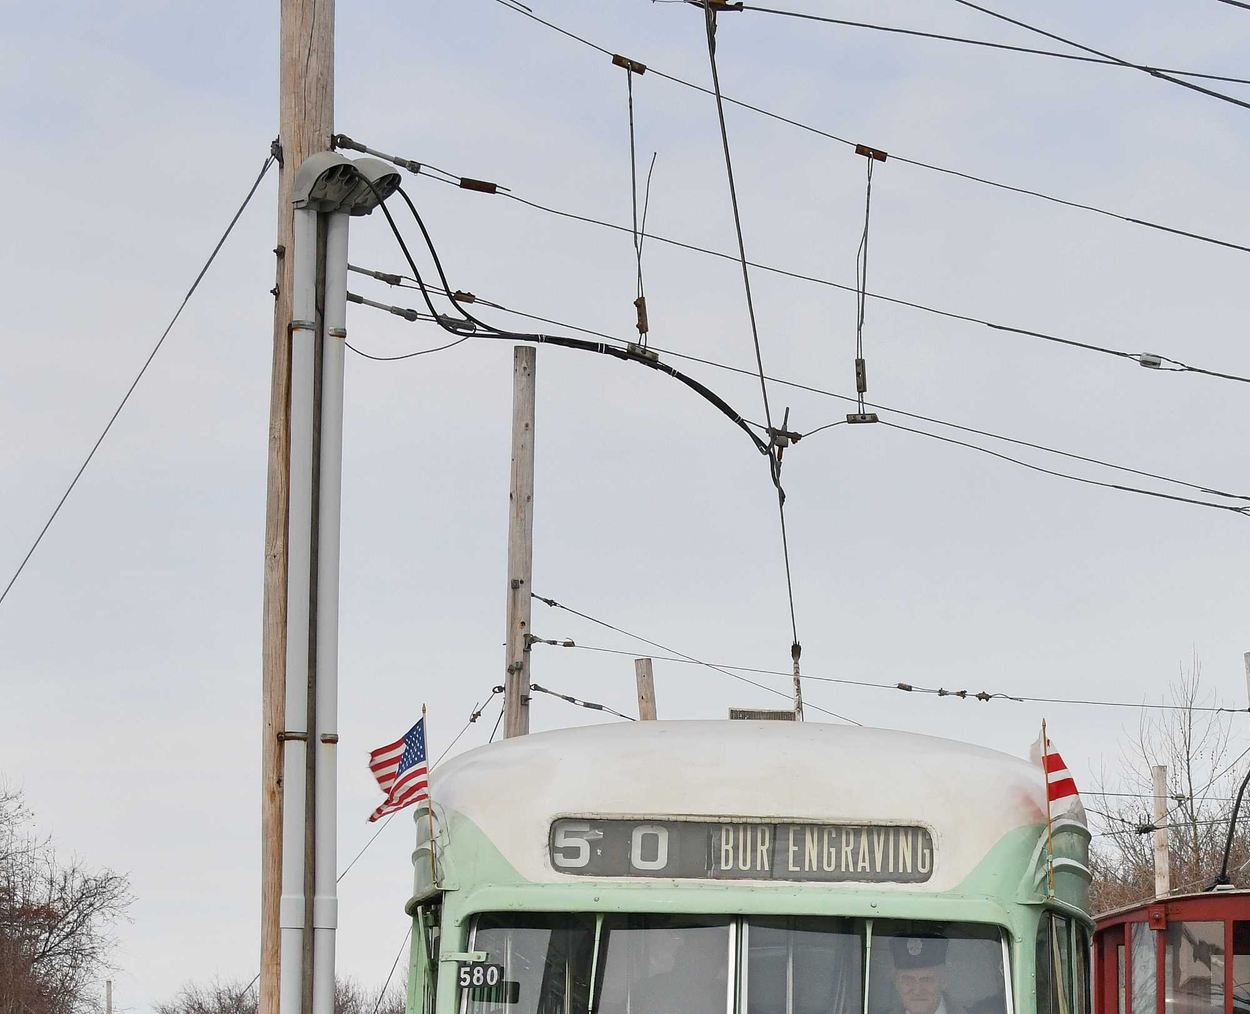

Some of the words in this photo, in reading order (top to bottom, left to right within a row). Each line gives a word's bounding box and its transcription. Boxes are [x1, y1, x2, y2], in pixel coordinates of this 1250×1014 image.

[720, 824, 771, 871] BUR
[788, 825, 930, 875] ENGRAVING
[460, 966, 498, 986] 580
